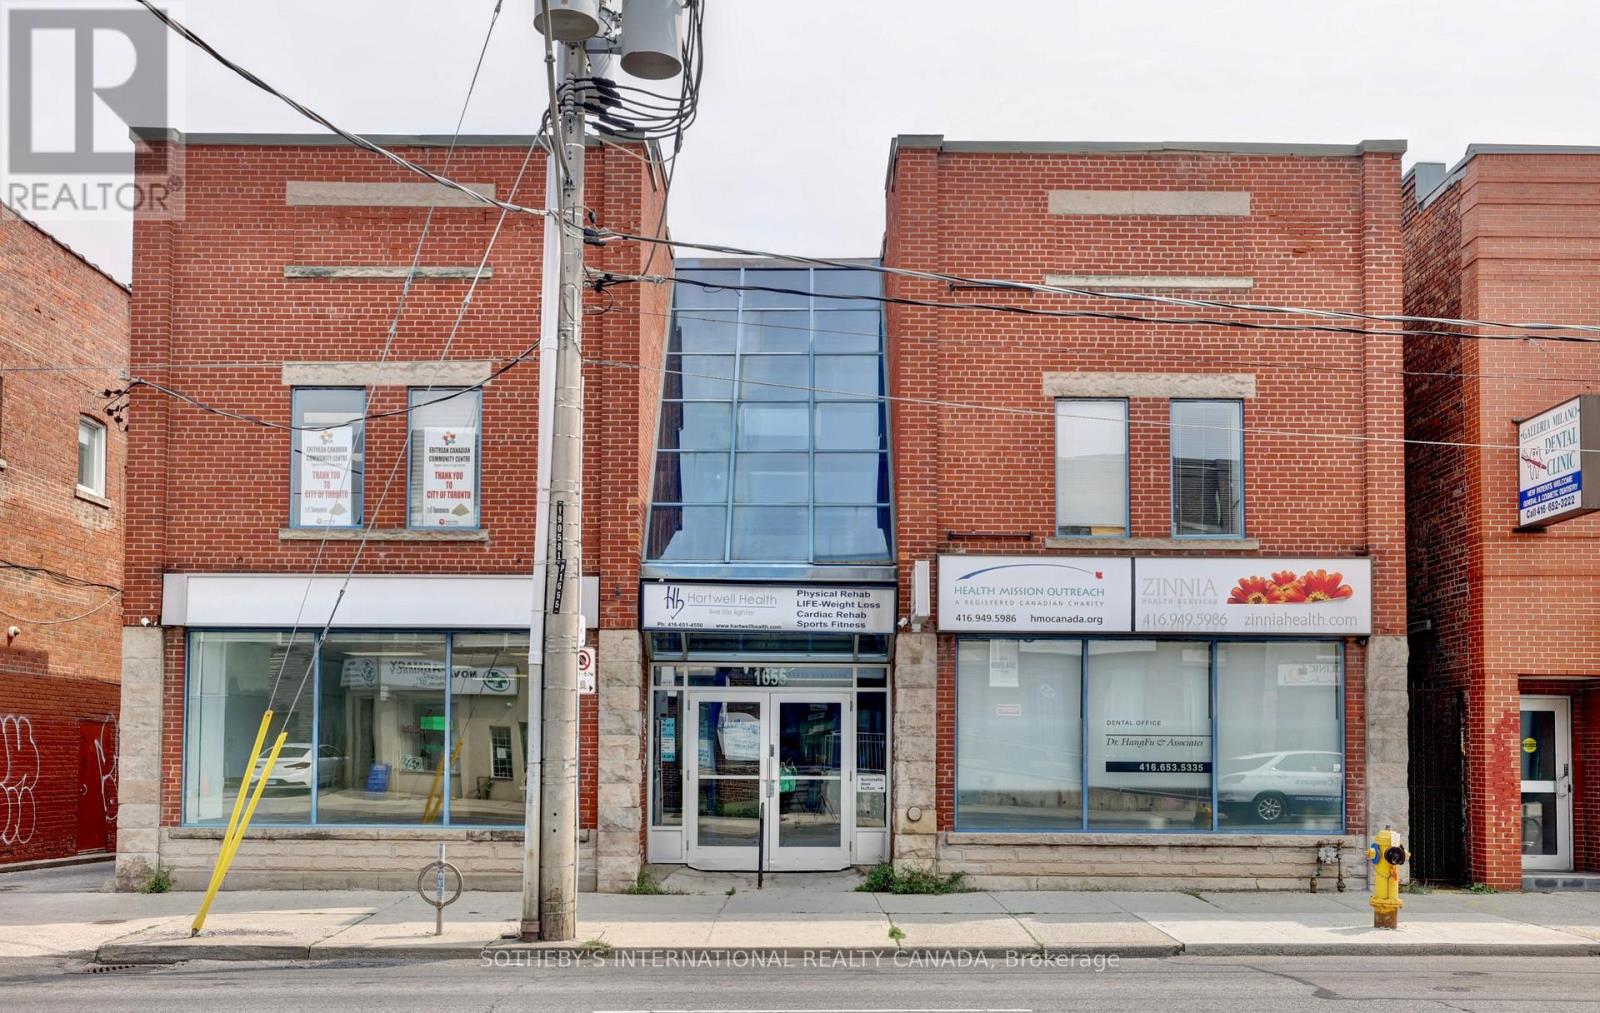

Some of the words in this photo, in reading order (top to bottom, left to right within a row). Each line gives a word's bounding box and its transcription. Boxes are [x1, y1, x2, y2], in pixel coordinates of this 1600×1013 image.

[1522, 420, 1551, 440] GALLERIA
[1552, 406, 1578, 427] MILANO
[1545, 427, 1578, 455] DENTAL
[428, 455, 454, 463] COMMUNITY
[455, 455, 471, 463] CENTRE
[1546, 450, 1576, 477] CLINIC
[312, 470, 330, 480] THANK
[331, 470, 341, 480] YOU
[435, 471, 452, 480] THANK
[453, 471, 464, 480] YOU
[323, 480, 331, 489] TO
[446, 481, 453, 489] TO
[304, 490, 317, 499] CITY
[317, 490, 325, 499] OF
[325, 490, 348, 499] TORONTO
[427, 490, 439, 499] CITY
[440, 490, 446, 499] OF
[447, 490, 471, 499] TORONTO
[954, 586, 996, 596] HEALTH
[999, 586, 1044, 597] MISSION
[1046, 587, 1105, 598] OUTREACH
[1142, 577, 1217, 597] ZINNIA
[688, 591, 736, 605] Hartwell
[739, 593, 778, 606] Health
[796, 589, 838, 599] Physical
[840, 590, 871, 598] Rehab
[796, 600, 855, 610] LIFE-Weight
[857, 601, 881, 609] Loss
[965, 599, 1015, 607] REGISTERED
[1068, 600, 1105, 608] CHARITY
[796, 610, 833, 619] Cardiac
[836, 611, 867, 619] Rehab
[955, 613, 1017, 623] 416.949.5986
[1029, 613, 1103, 626] hmocanada.org
[1142, 613, 1228, 627] 416.949.5986
[1244, 611, 1358, 628] zinniahealth.com
[796, 620, 829, 629] Sports
[831, 620, 866, 629] Fitness
[753, 667, 787, 686] 1655
[1135, 719, 1161, 727] OFFICE
[1106, 737, 1119, 746] Dr.
[1120, 737, 1155, 749] HangFu
[1156, 738, 1166, 746] &
[1166, 737, 1205, 747] Associates
[1138, 762, 1204, 772] 416.653.5335
